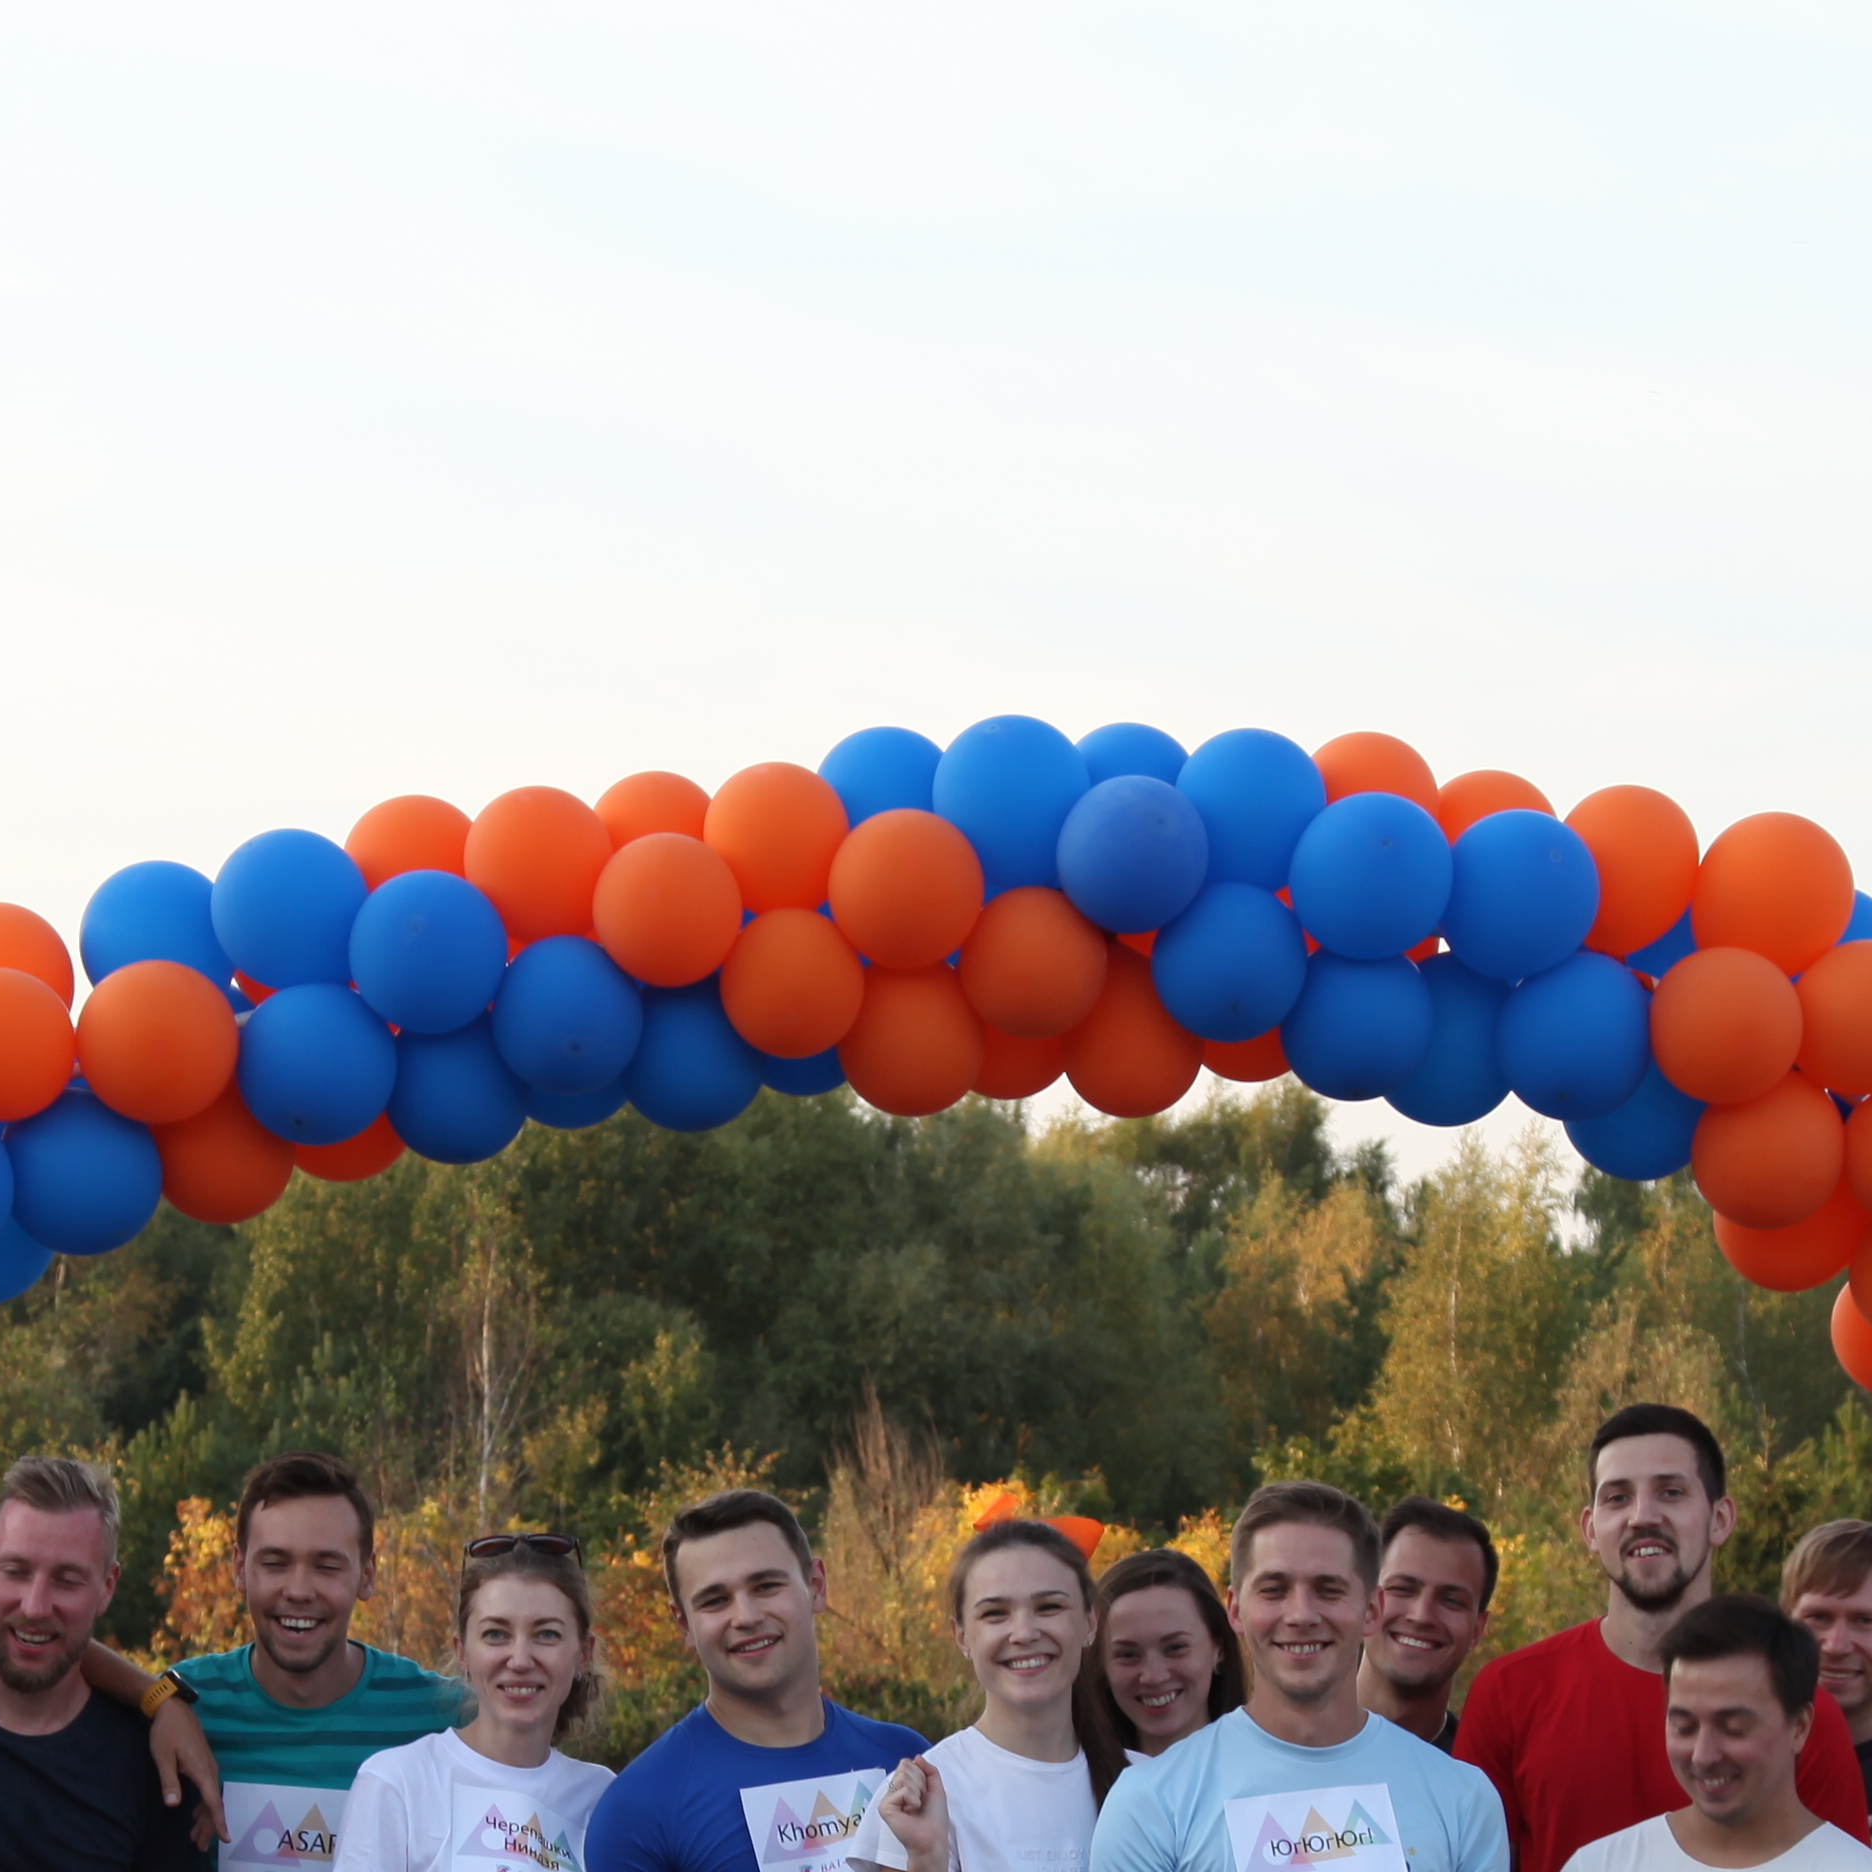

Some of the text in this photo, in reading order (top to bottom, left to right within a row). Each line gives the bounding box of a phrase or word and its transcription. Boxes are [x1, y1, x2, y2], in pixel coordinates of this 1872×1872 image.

[485, 1815, 571, 1859] Черепашки
[777, 1807, 866, 1843] Khomya
[1270, 1827, 1374, 1857] ЮгЮгЮг!
[504, 1837, 560, 1872] Ниндзя
